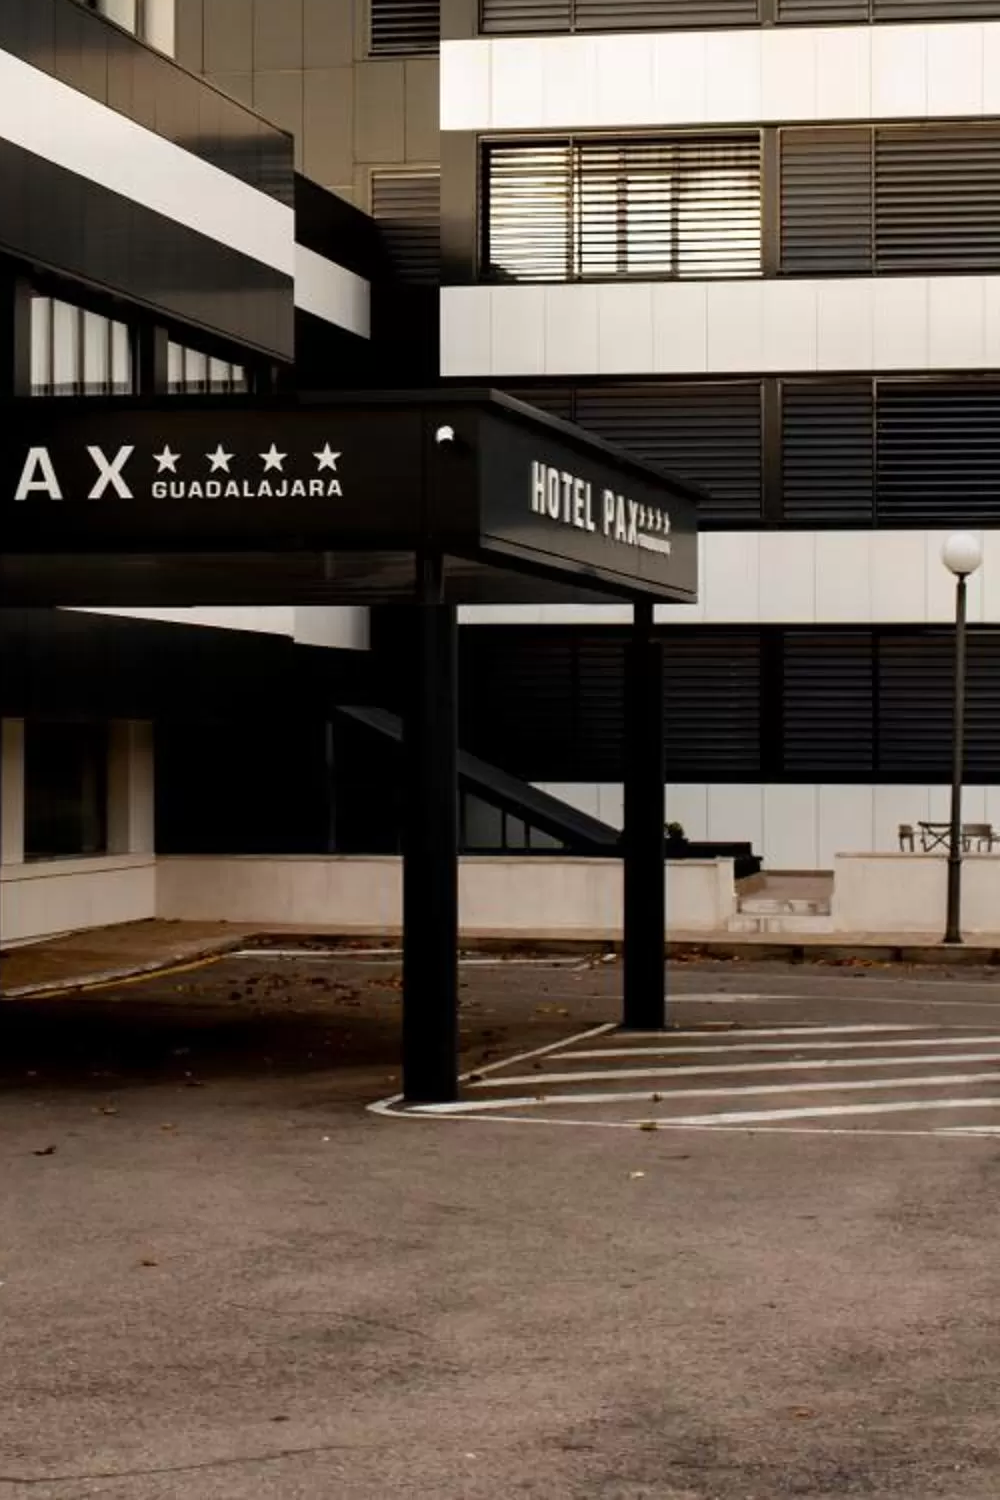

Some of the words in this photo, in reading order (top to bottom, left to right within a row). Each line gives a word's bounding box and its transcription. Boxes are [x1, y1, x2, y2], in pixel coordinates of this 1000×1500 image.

[151, 479, 343, 499] GUADALAJARA
[531, 460, 596, 532] HOTEL
[602, 489, 639, 545] PAX
